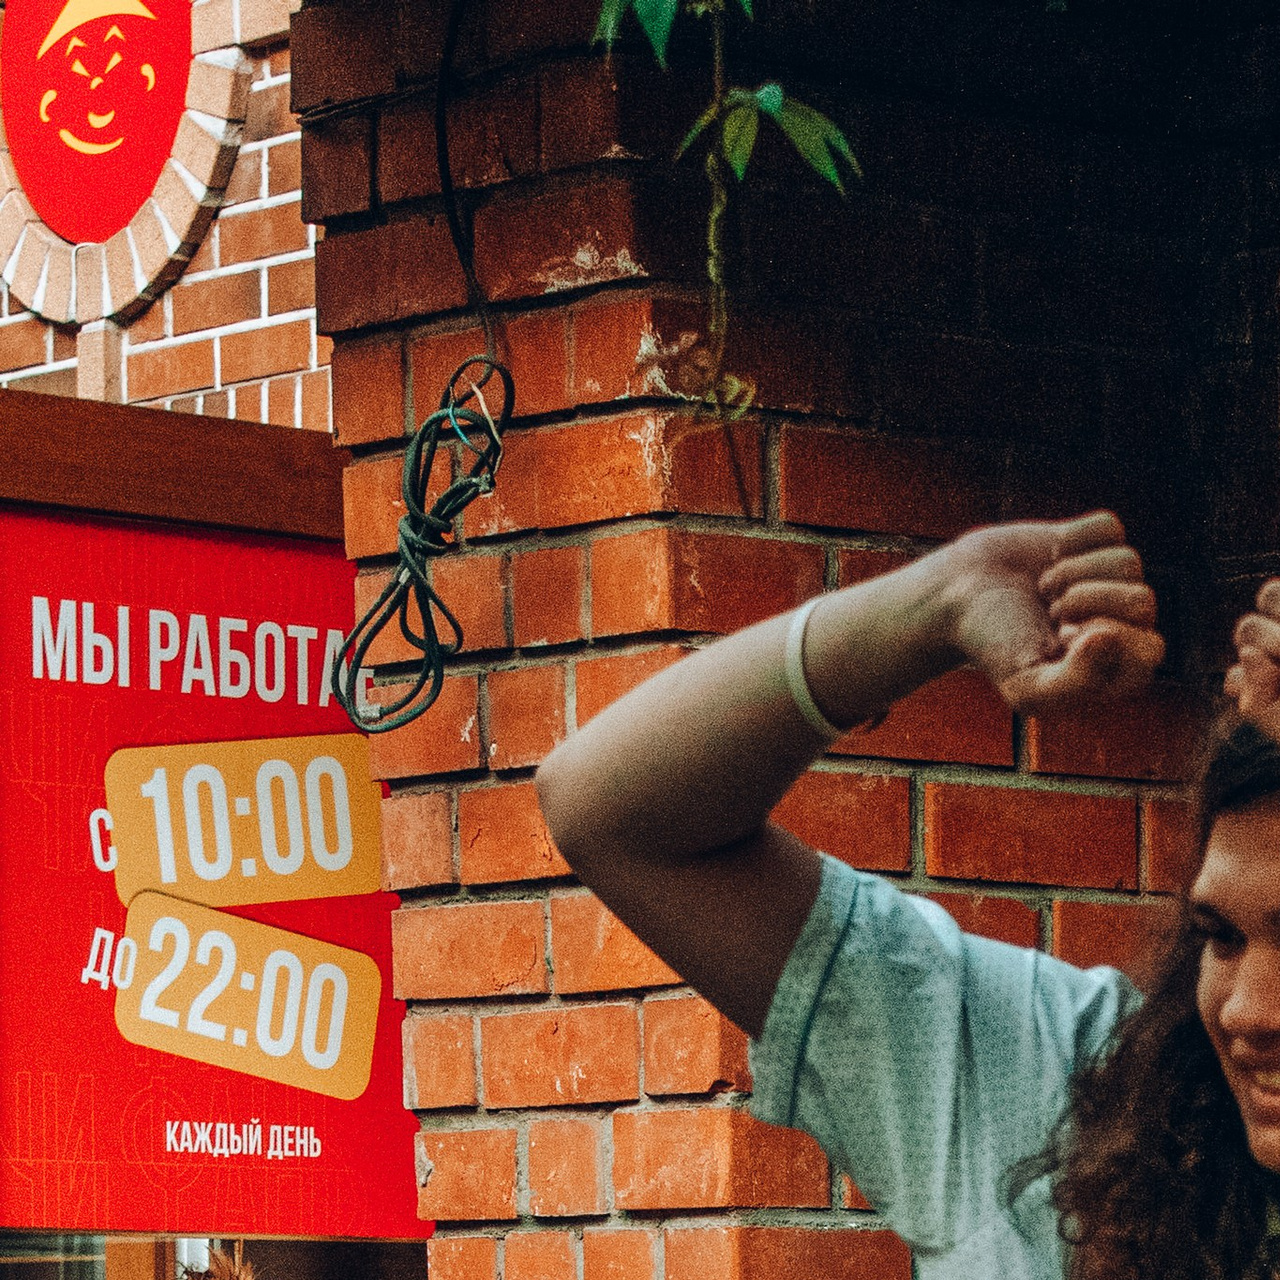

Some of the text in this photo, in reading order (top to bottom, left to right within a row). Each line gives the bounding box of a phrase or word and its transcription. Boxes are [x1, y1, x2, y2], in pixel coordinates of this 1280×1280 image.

[31, 595, 131, 688] МЫ
[88, 807, 119, 873] С
[140, 755, 353, 884] 10:00
[80, 916, 349, 1070] ДО 22:00
[165, 1117, 322, 1160] КАЖДЫЙ ДЕНЬ
